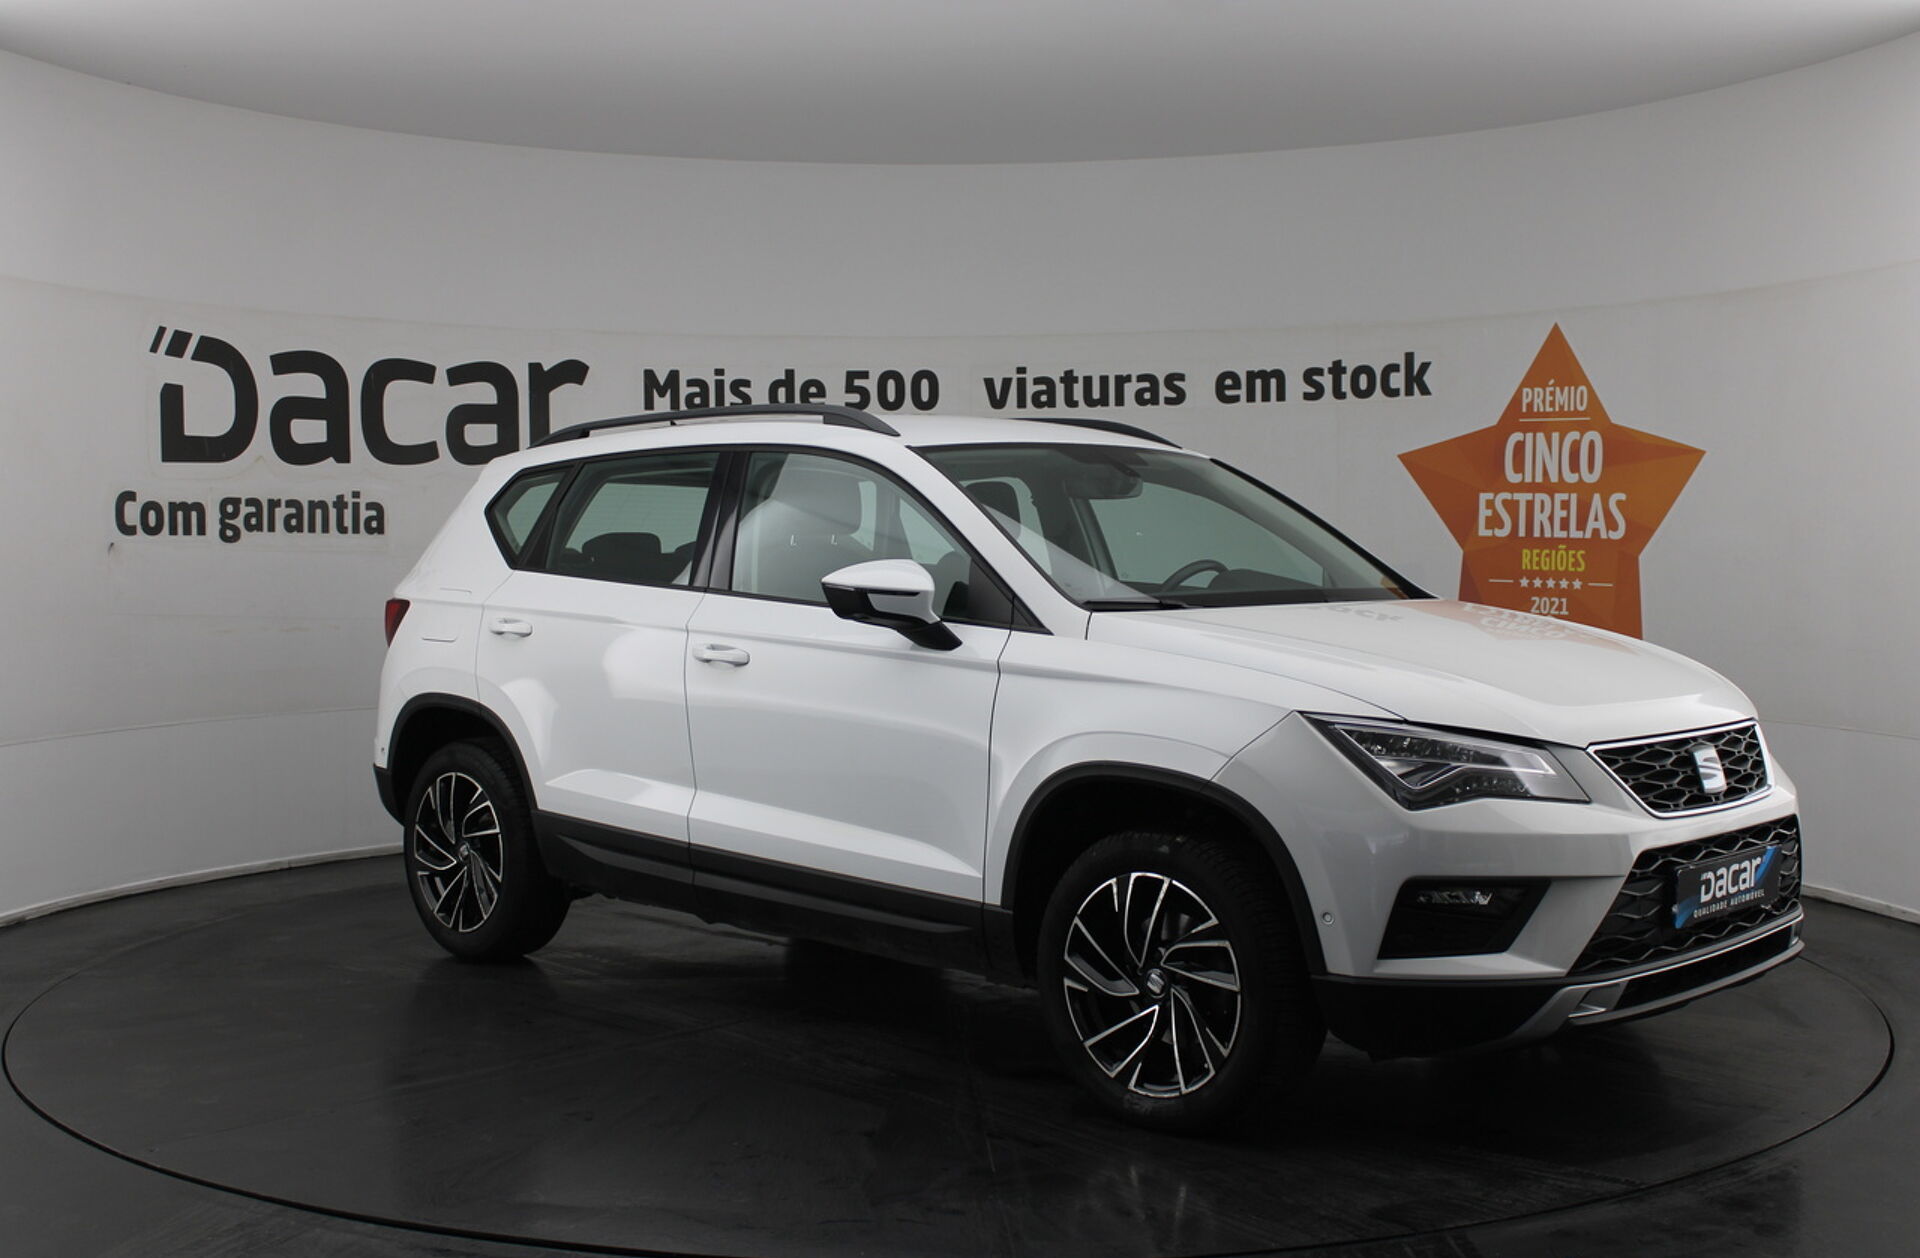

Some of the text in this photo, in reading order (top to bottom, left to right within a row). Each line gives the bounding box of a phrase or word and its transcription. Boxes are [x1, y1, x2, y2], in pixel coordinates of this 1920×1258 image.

[150, 326, 590, 466] Dacar
[643, 352, 1432, 412] Mais de 500 viaturas em stock
[1521, 379, 1588, 413] PRÉMIO
[1504, 431, 1603, 484] CINCO
[114, 491, 386, 544] Com garantia
[1477, 492, 1627, 540] ESTRELAS
[1521, 544, 1586, 572] REGIÕES
[1530, 596, 1569, 616] 2021
[1700, 856, 1762, 904] Dacar
